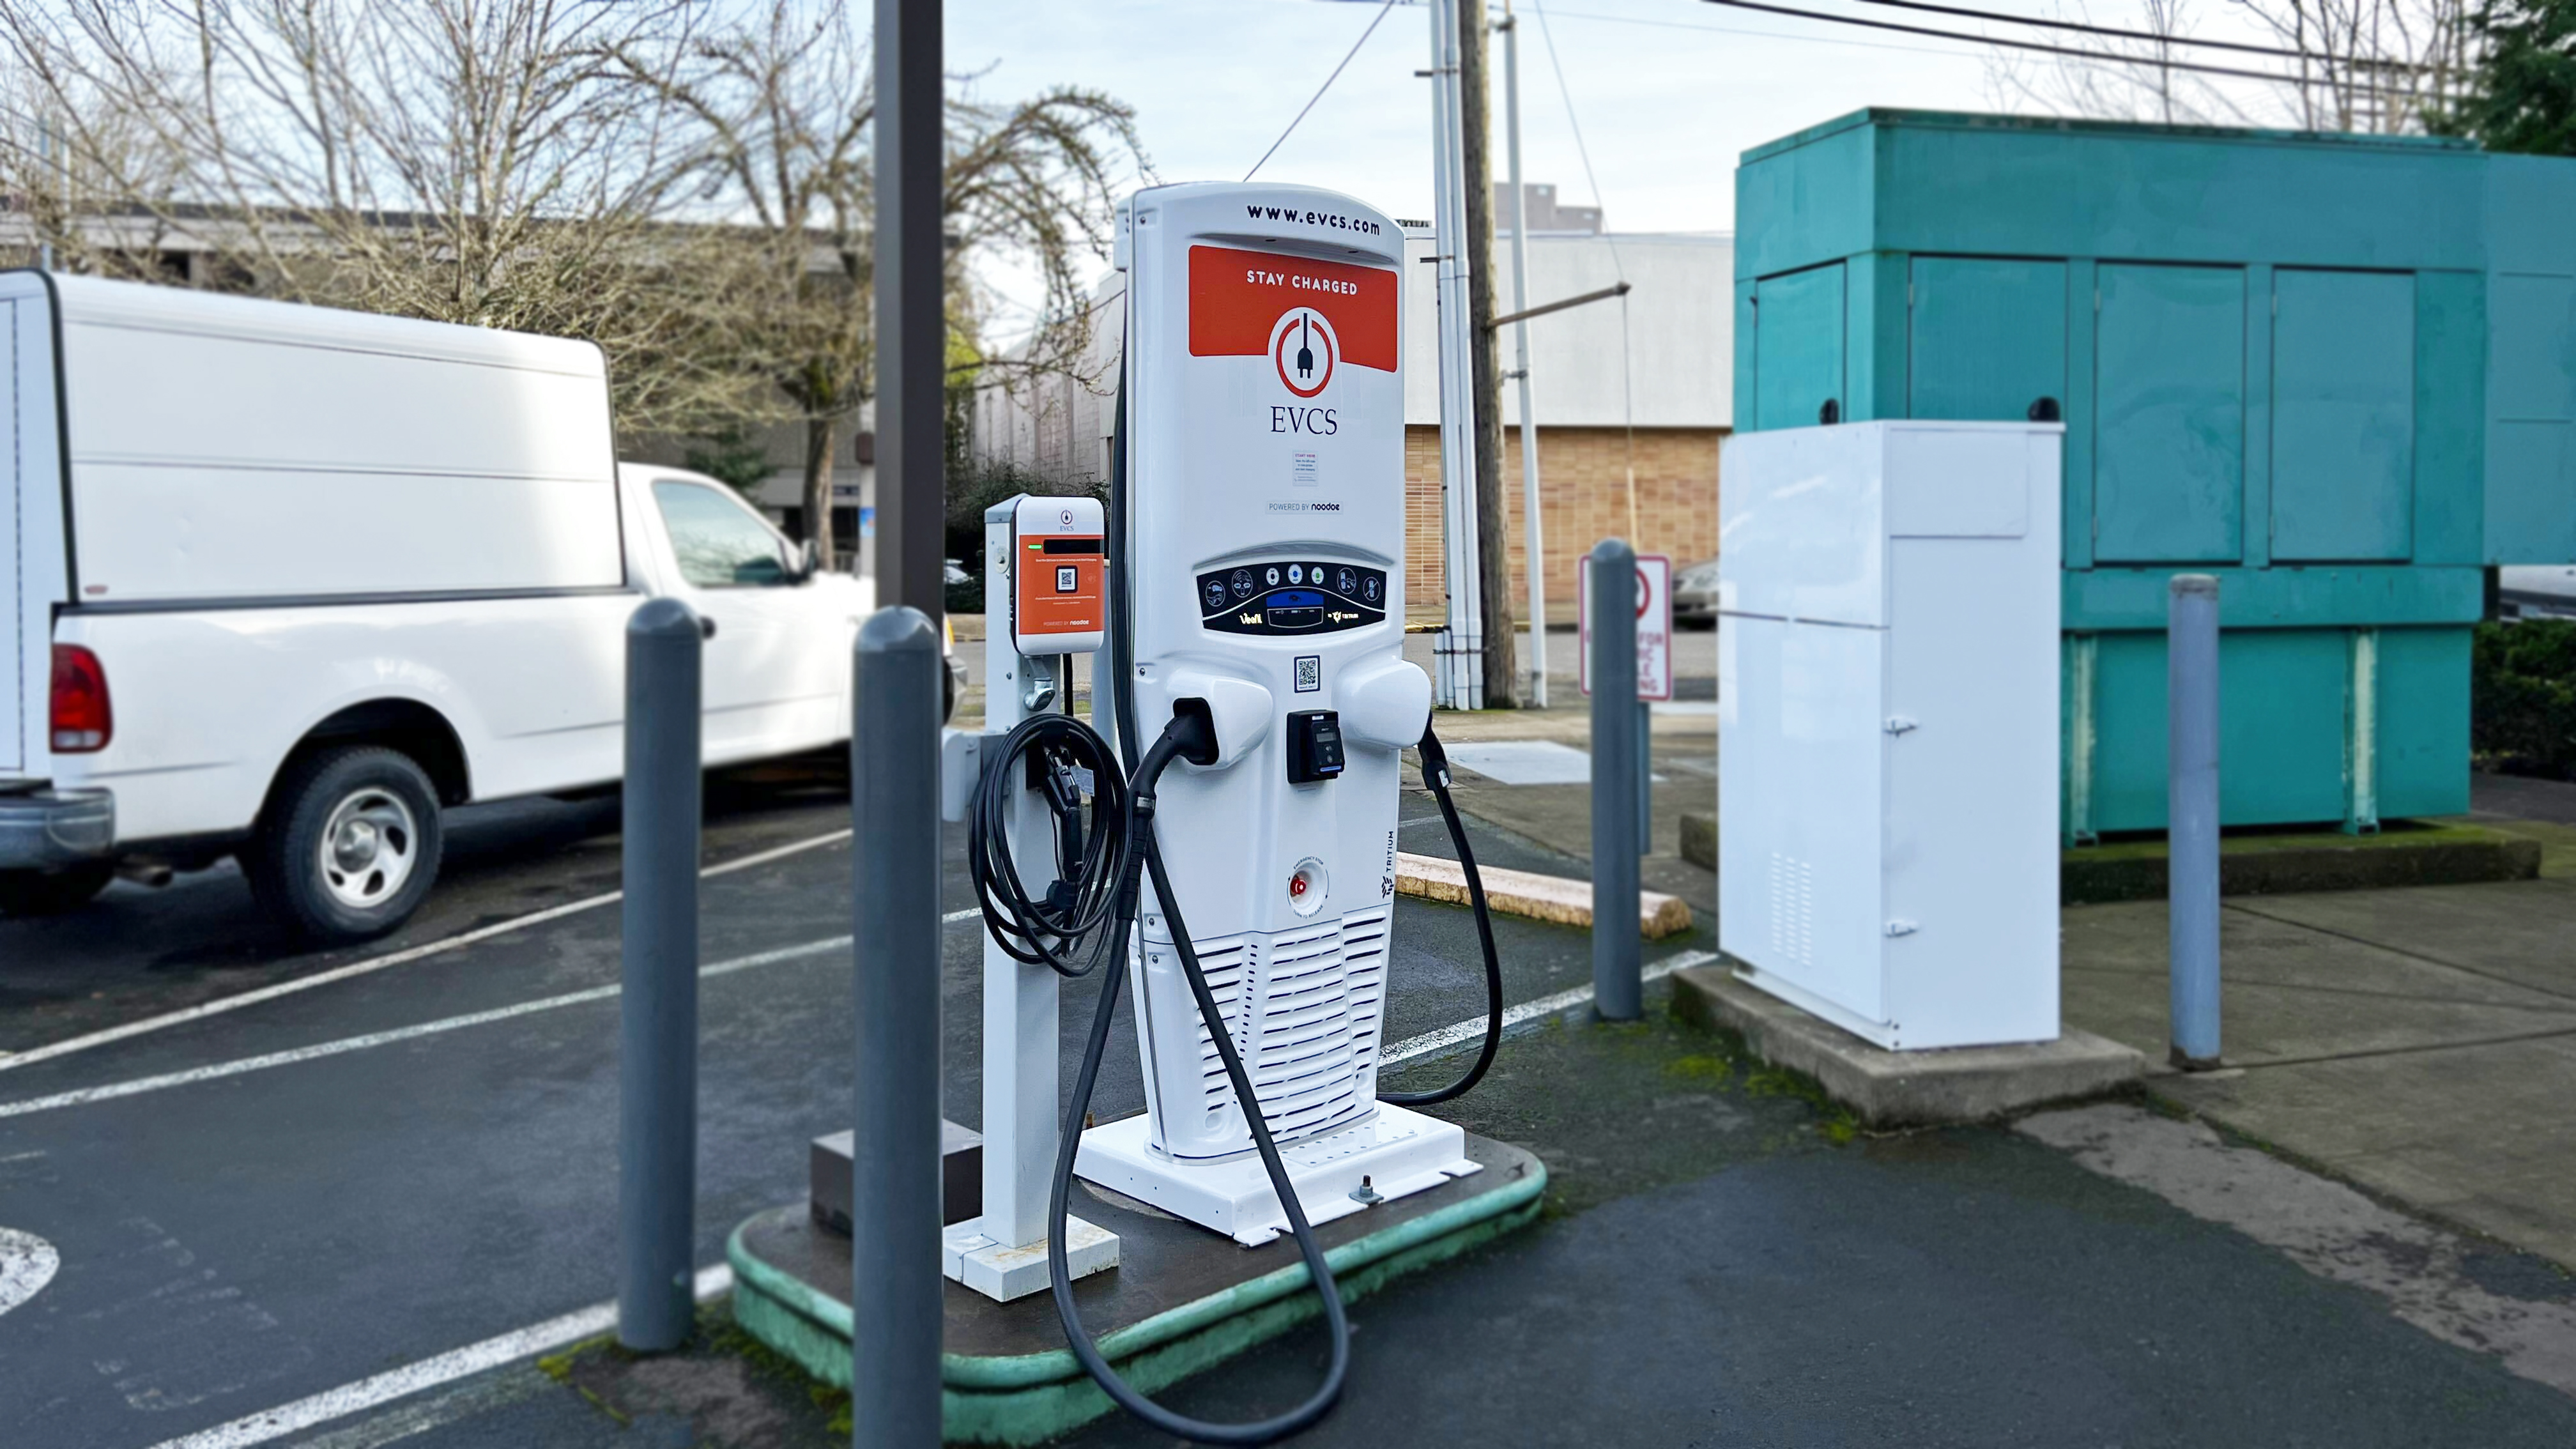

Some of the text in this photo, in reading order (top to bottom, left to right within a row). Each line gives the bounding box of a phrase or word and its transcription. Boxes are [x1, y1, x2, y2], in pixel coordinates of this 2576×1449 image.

[1247, 205, 1380, 236] www.evcs.com
[1246, 270, 1357, 295] STAY CHARGED
[1270, 406, 1337, 435] EVCS
[1311, 502, 1340, 510] noodoe
[1308, 905, 1323, 917] RELEASE
